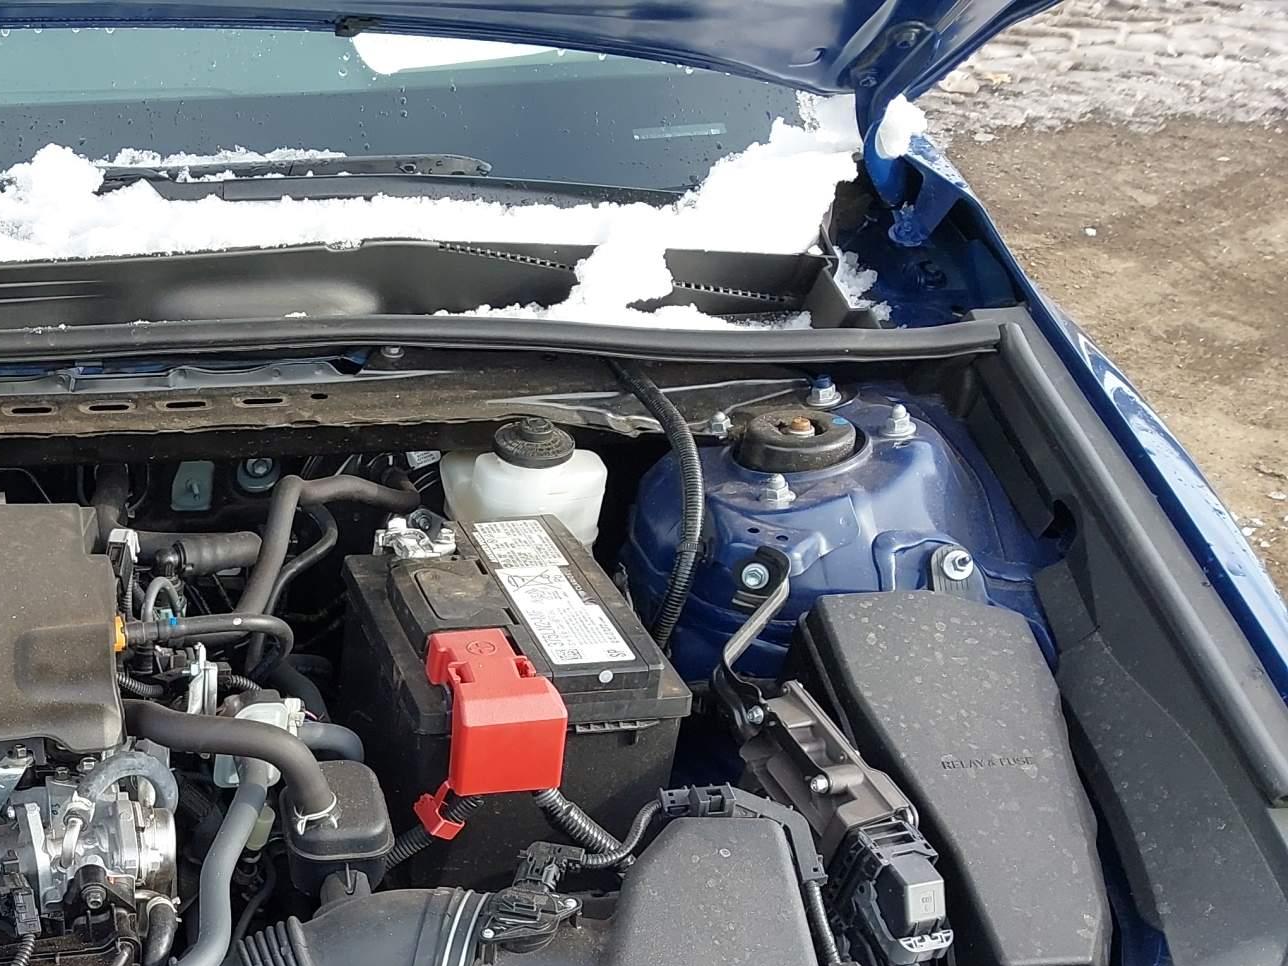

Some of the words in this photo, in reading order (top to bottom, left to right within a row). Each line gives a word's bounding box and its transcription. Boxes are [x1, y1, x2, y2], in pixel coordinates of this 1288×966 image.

[940, 759, 984, 770] RELAY
[987, 759, 996, 767] &
[999, 757, 1034, 767] FUSE
